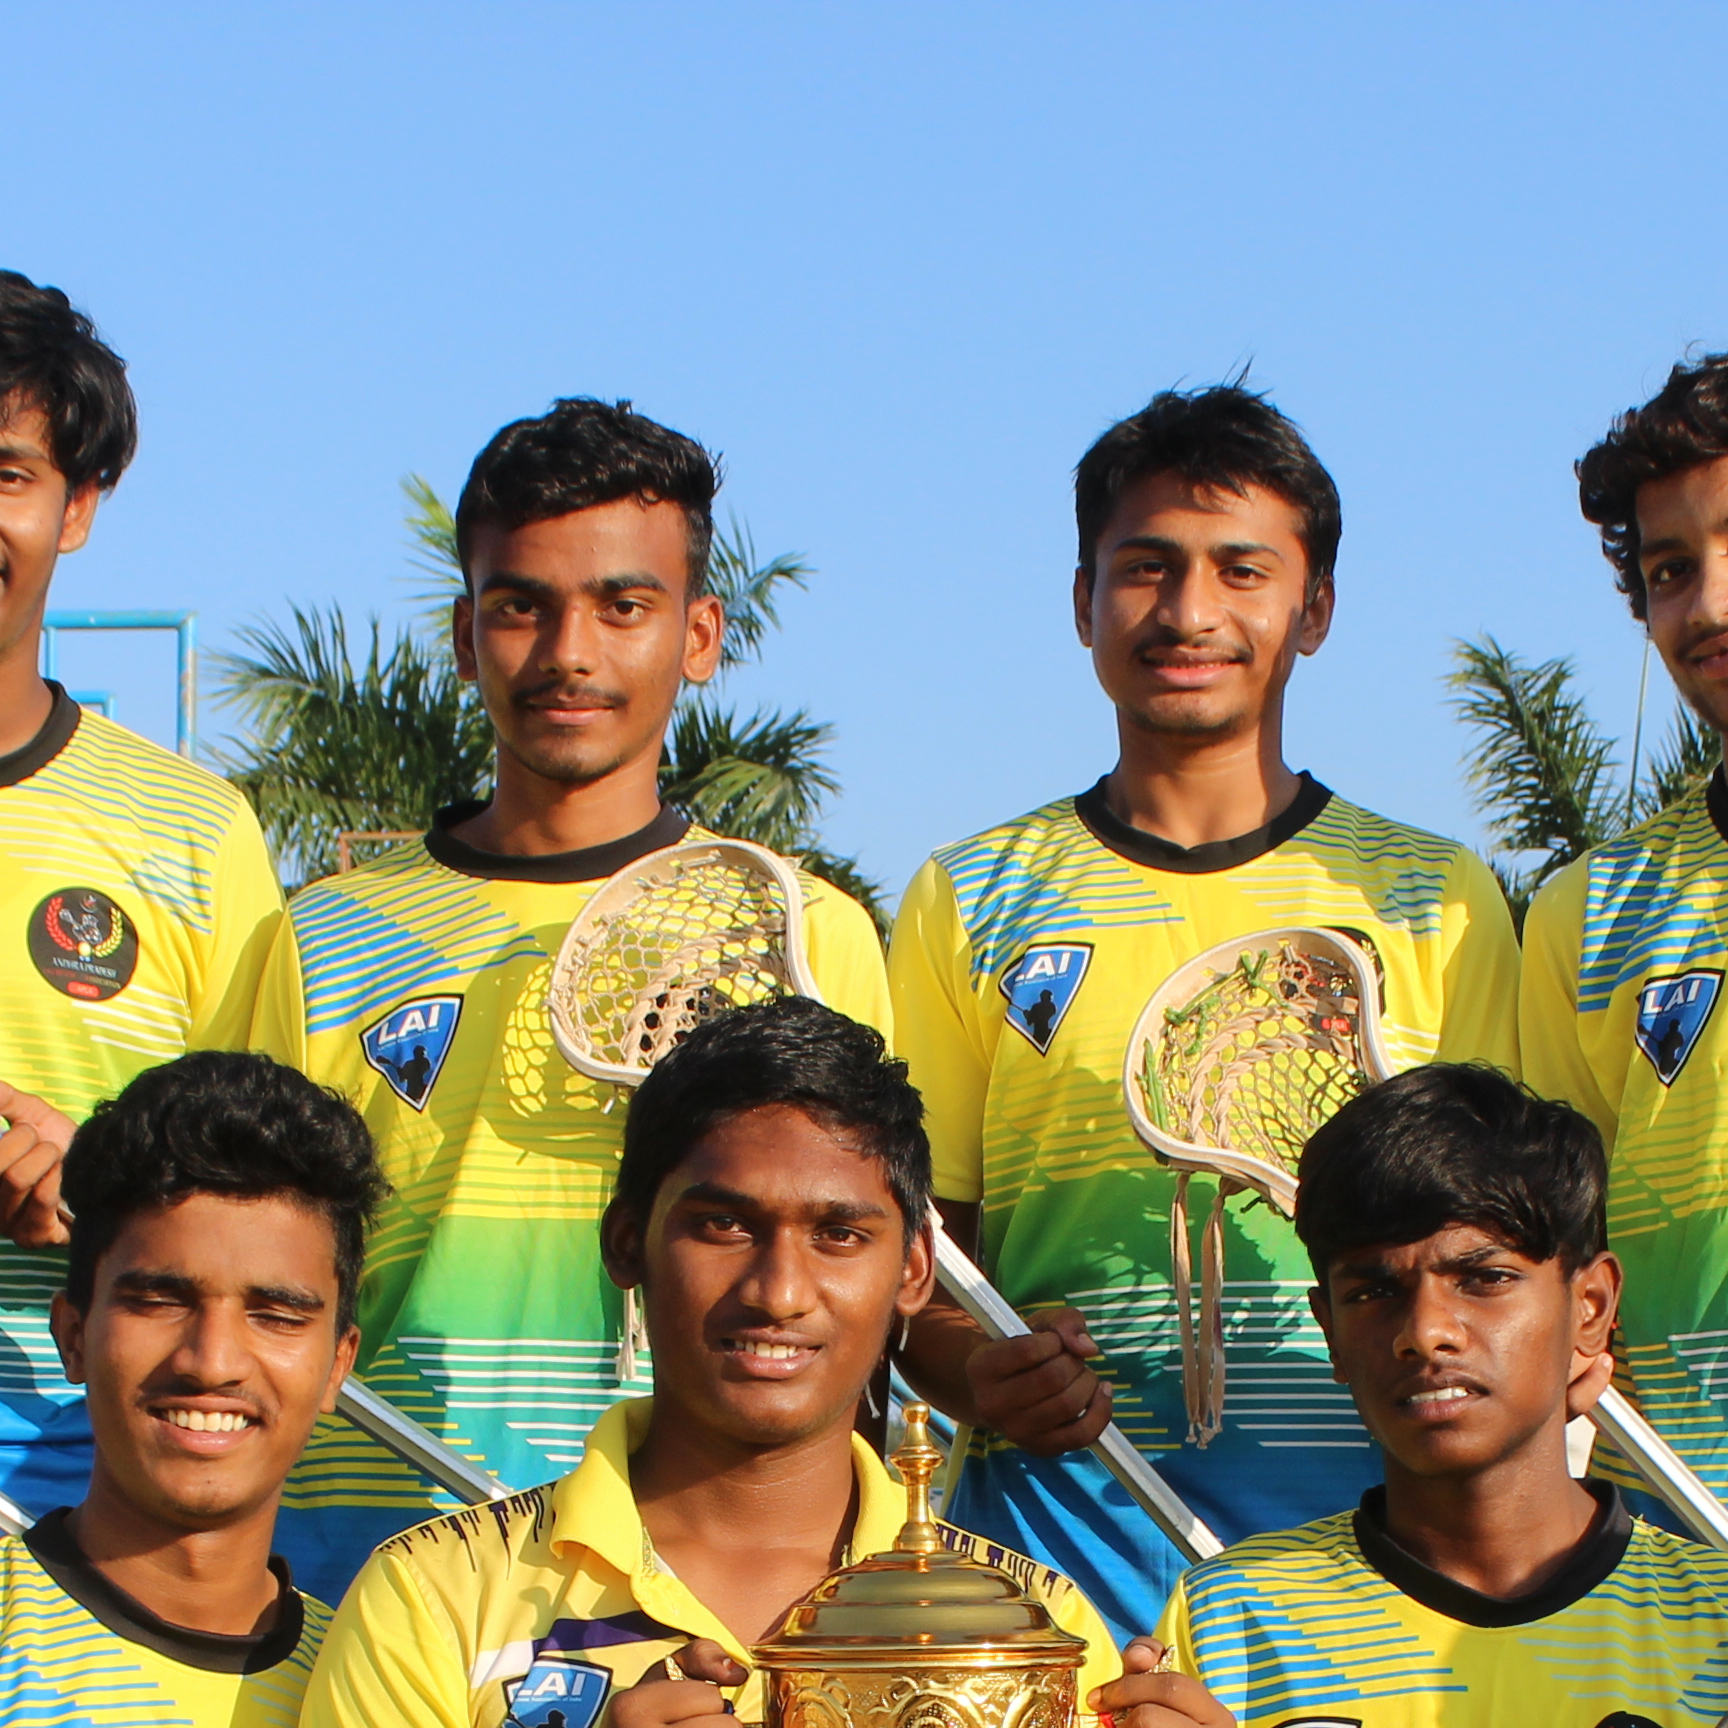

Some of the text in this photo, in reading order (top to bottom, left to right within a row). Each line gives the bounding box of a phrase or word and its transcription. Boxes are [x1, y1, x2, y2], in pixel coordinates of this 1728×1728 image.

[1014, 951, 1072, 983] AI
[1642, 979, 1701, 1015] LAI
[377, 1004, 441, 1045] LAI
